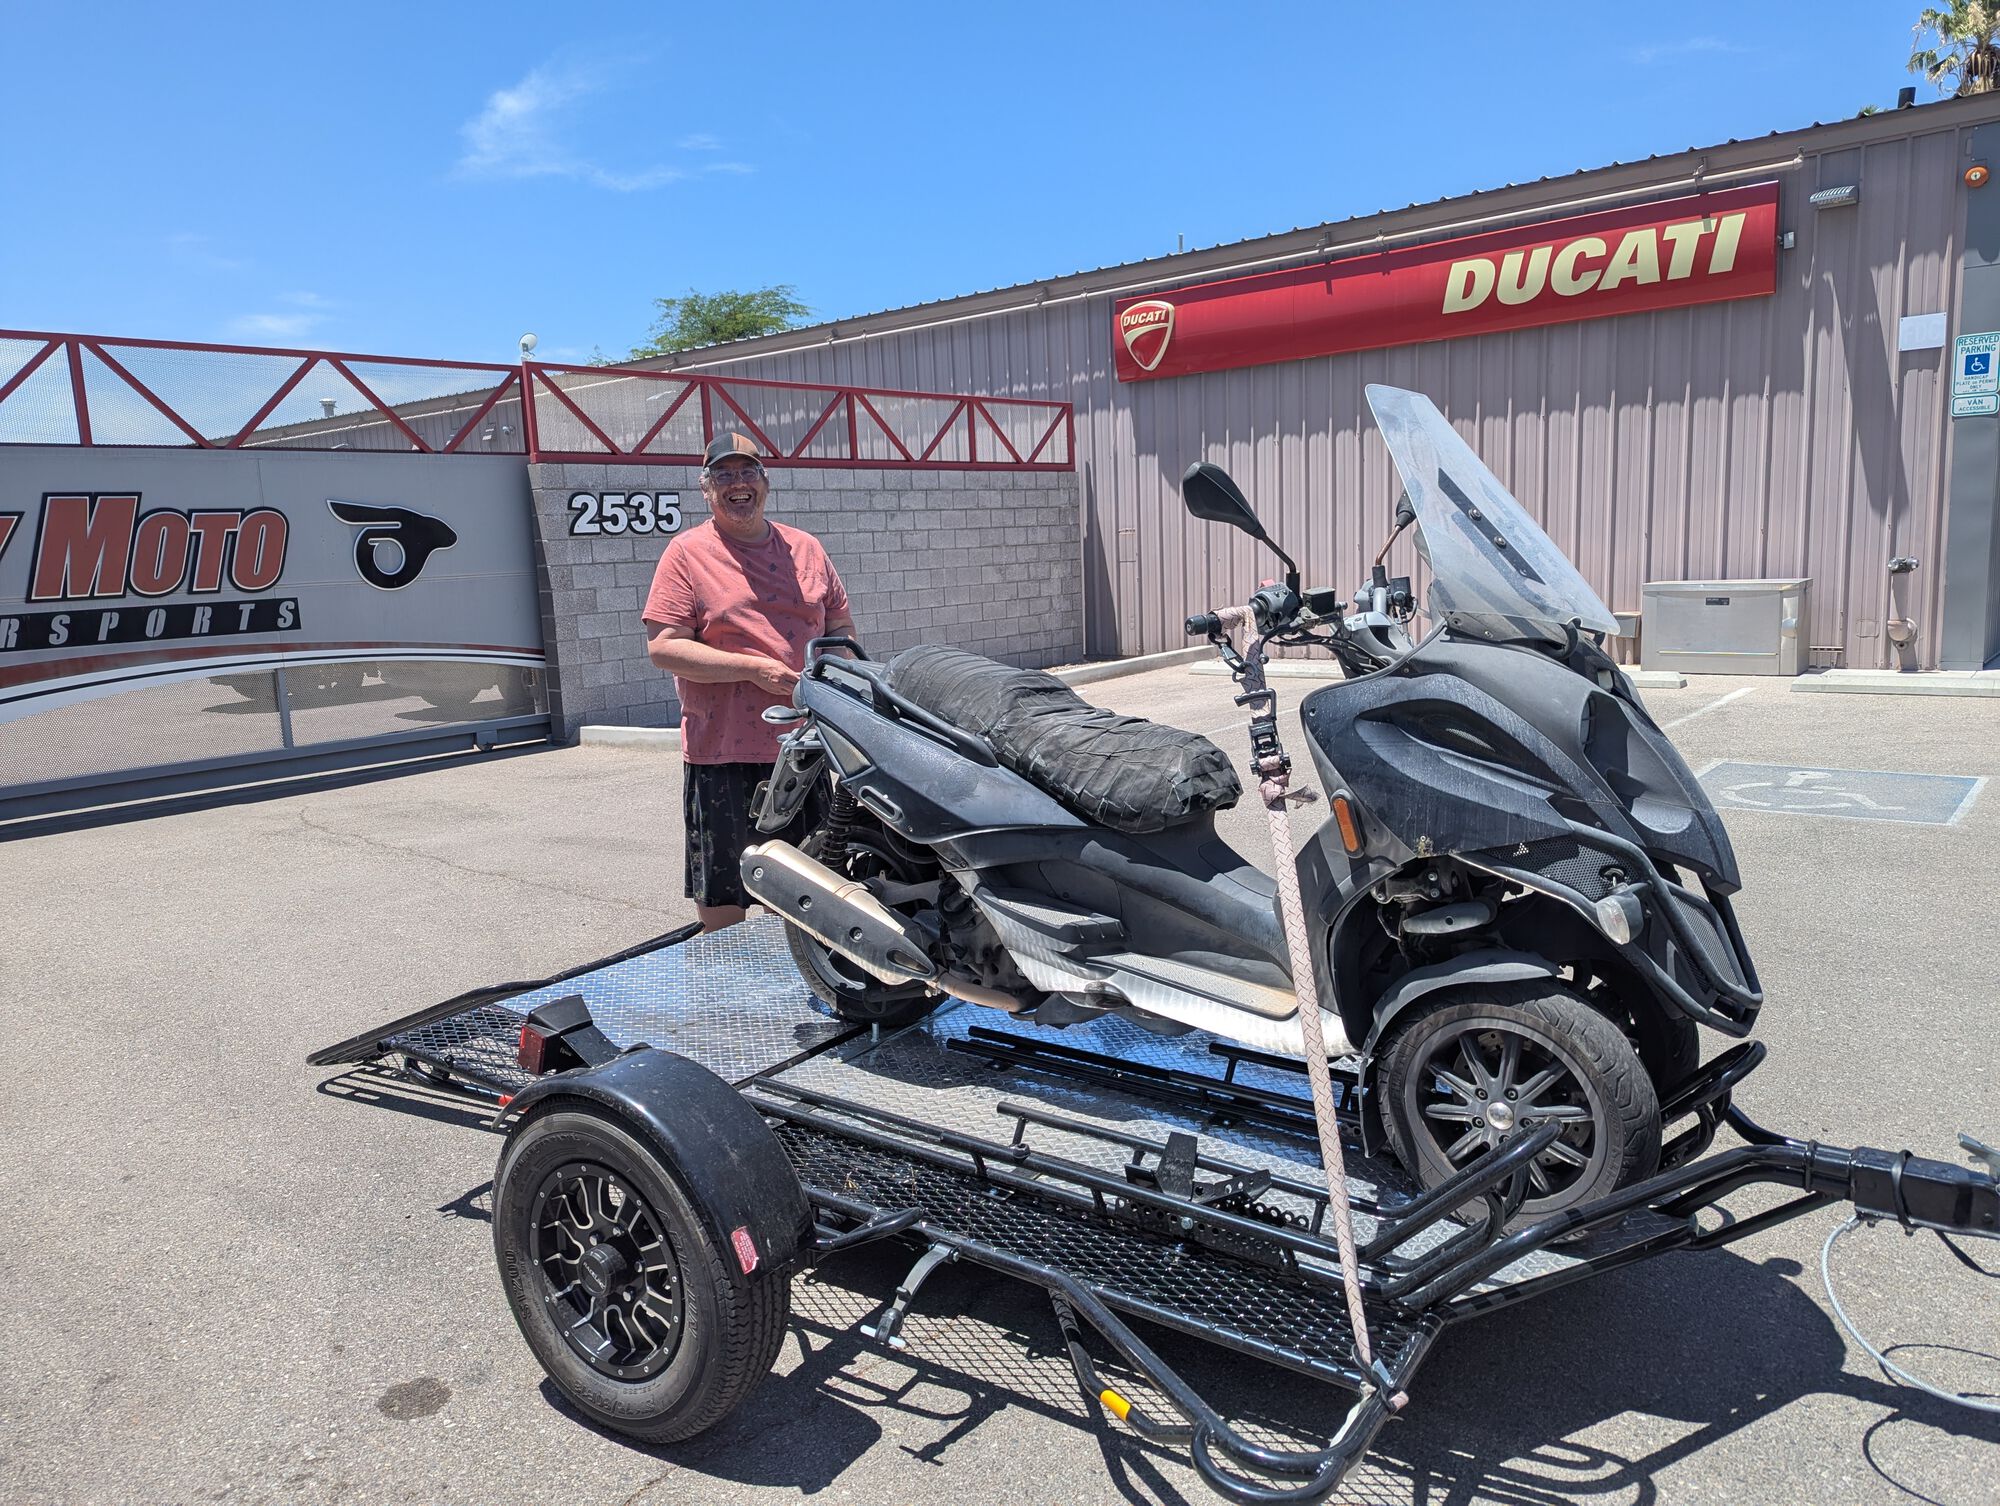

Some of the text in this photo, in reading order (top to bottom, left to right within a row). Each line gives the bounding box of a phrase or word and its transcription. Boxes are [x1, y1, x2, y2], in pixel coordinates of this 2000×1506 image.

[1442, 213, 1747, 315] DUCATI
[1123, 309, 1167, 327] DUCATI
[1958, 335, 2000, 346] RESERVED
[1960, 344, 1996, 354] PARKING
[570, 493, 683, 535] 2535
[27, 492, 288, 603] MOTO
